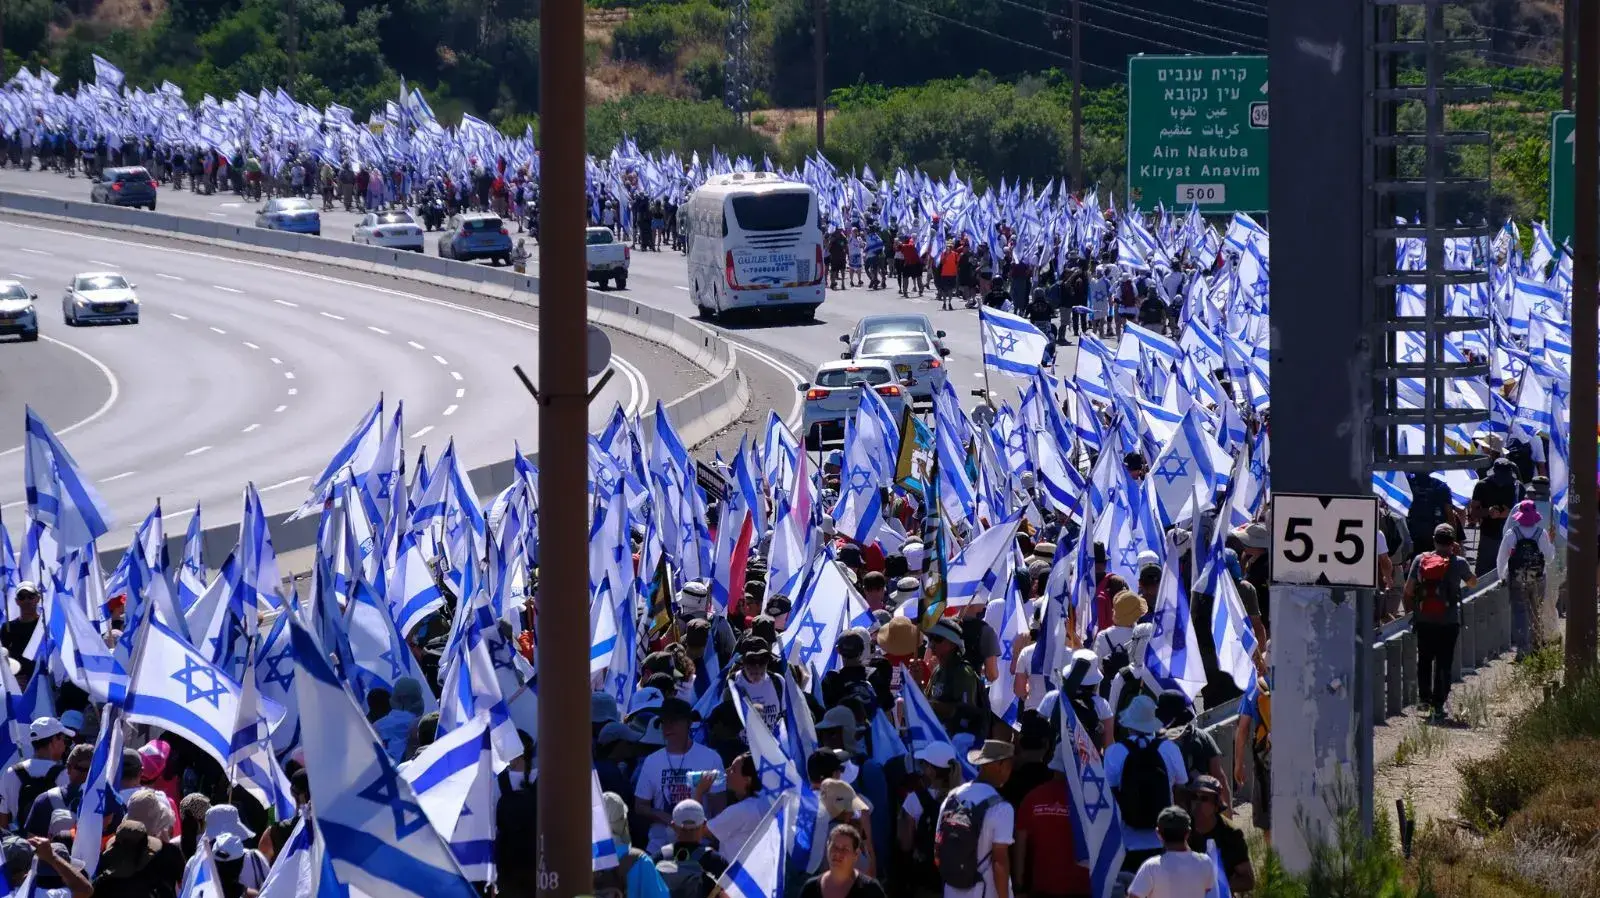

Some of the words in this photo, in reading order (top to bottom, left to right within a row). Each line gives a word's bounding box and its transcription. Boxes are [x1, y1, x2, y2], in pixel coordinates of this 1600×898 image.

[1158, 69, 1203, 81] ענבים
[1212, 68, 1247, 83] קרית
[1164, 88, 1208, 102] נקובא
[1217, 88, 1240, 102] עין
[1170, 106, 1197, 120] نقوبا
[1205, 106, 1228, 119] عين
[1202, 123, 1241, 139] كريات
[1153, 146, 1179, 158] Ain
[1188, 146, 1249, 158] Nakuba
[1140, 165, 1191, 179] Kiryat
[1200, 165, 1260, 177] Anavim
[1186, 188, 1215, 200] 500
[1283, 517, 1364, 565] 5.5
